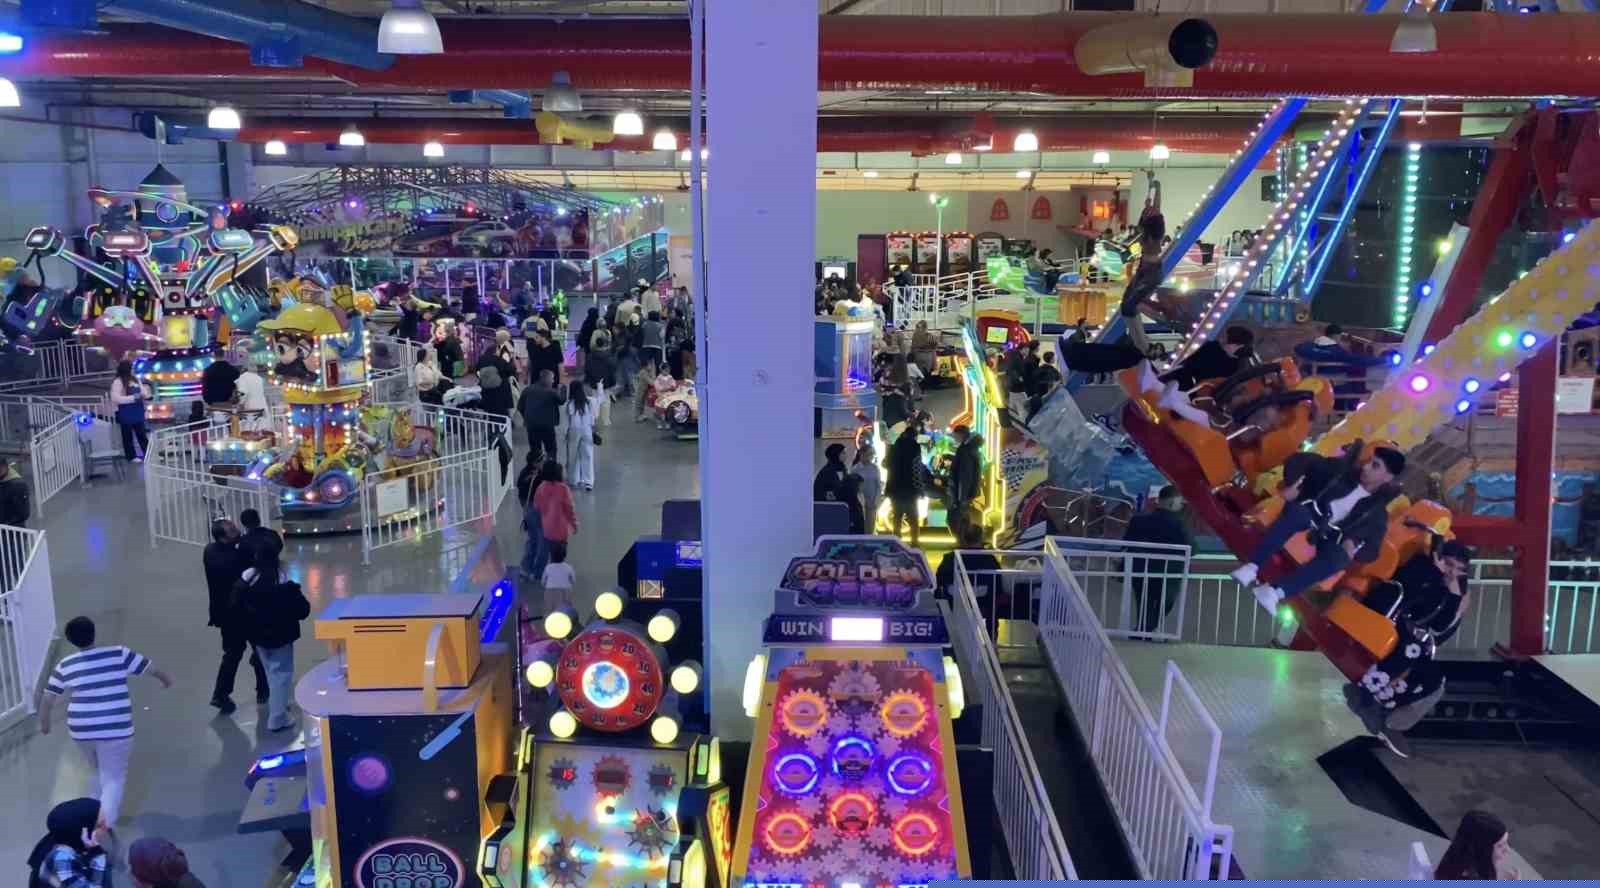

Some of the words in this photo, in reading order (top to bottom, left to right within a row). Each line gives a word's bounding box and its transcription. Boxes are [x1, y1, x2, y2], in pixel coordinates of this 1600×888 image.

[795, 562, 925, 583] GOLDEN
[781, 621, 825, 636] WIN
[889, 621, 933, 637] BIG!
[579, 643, 593, 654] 15
[623, 643, 636, 654] 20
[562, 768, 574, 780] 15
[372, 853, 447, 874] BALL
[373, 874, 453, 888] DROP
